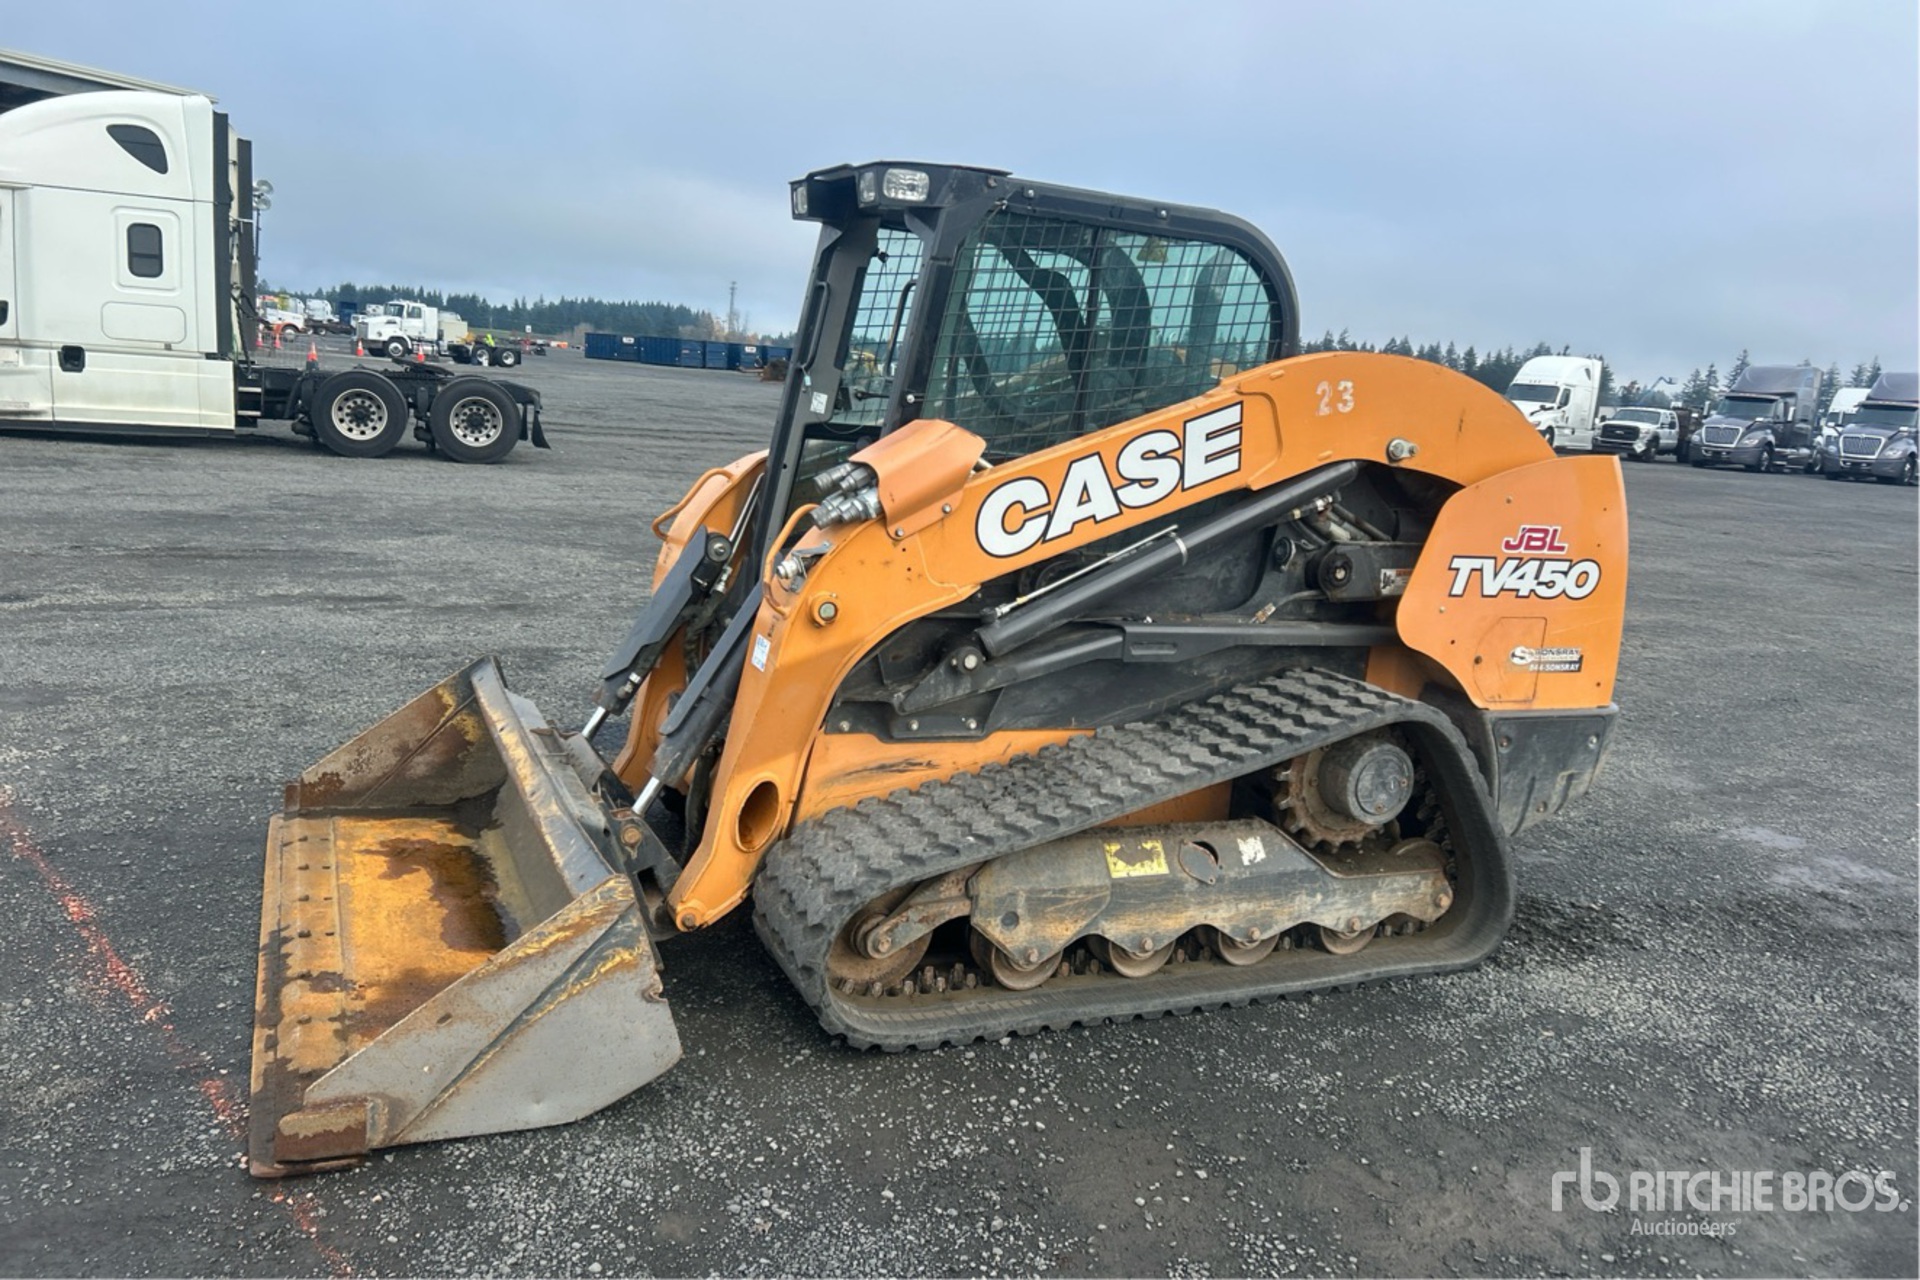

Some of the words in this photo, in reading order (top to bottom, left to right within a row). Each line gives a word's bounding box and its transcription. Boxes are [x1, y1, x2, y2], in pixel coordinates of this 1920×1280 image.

[1315, 379, 1355, 416] 23
[975, 400, 1243, 559] CASE
[1503, 525, 1568, 554] JBL
[1448, 555, 1602, 600] TV450
